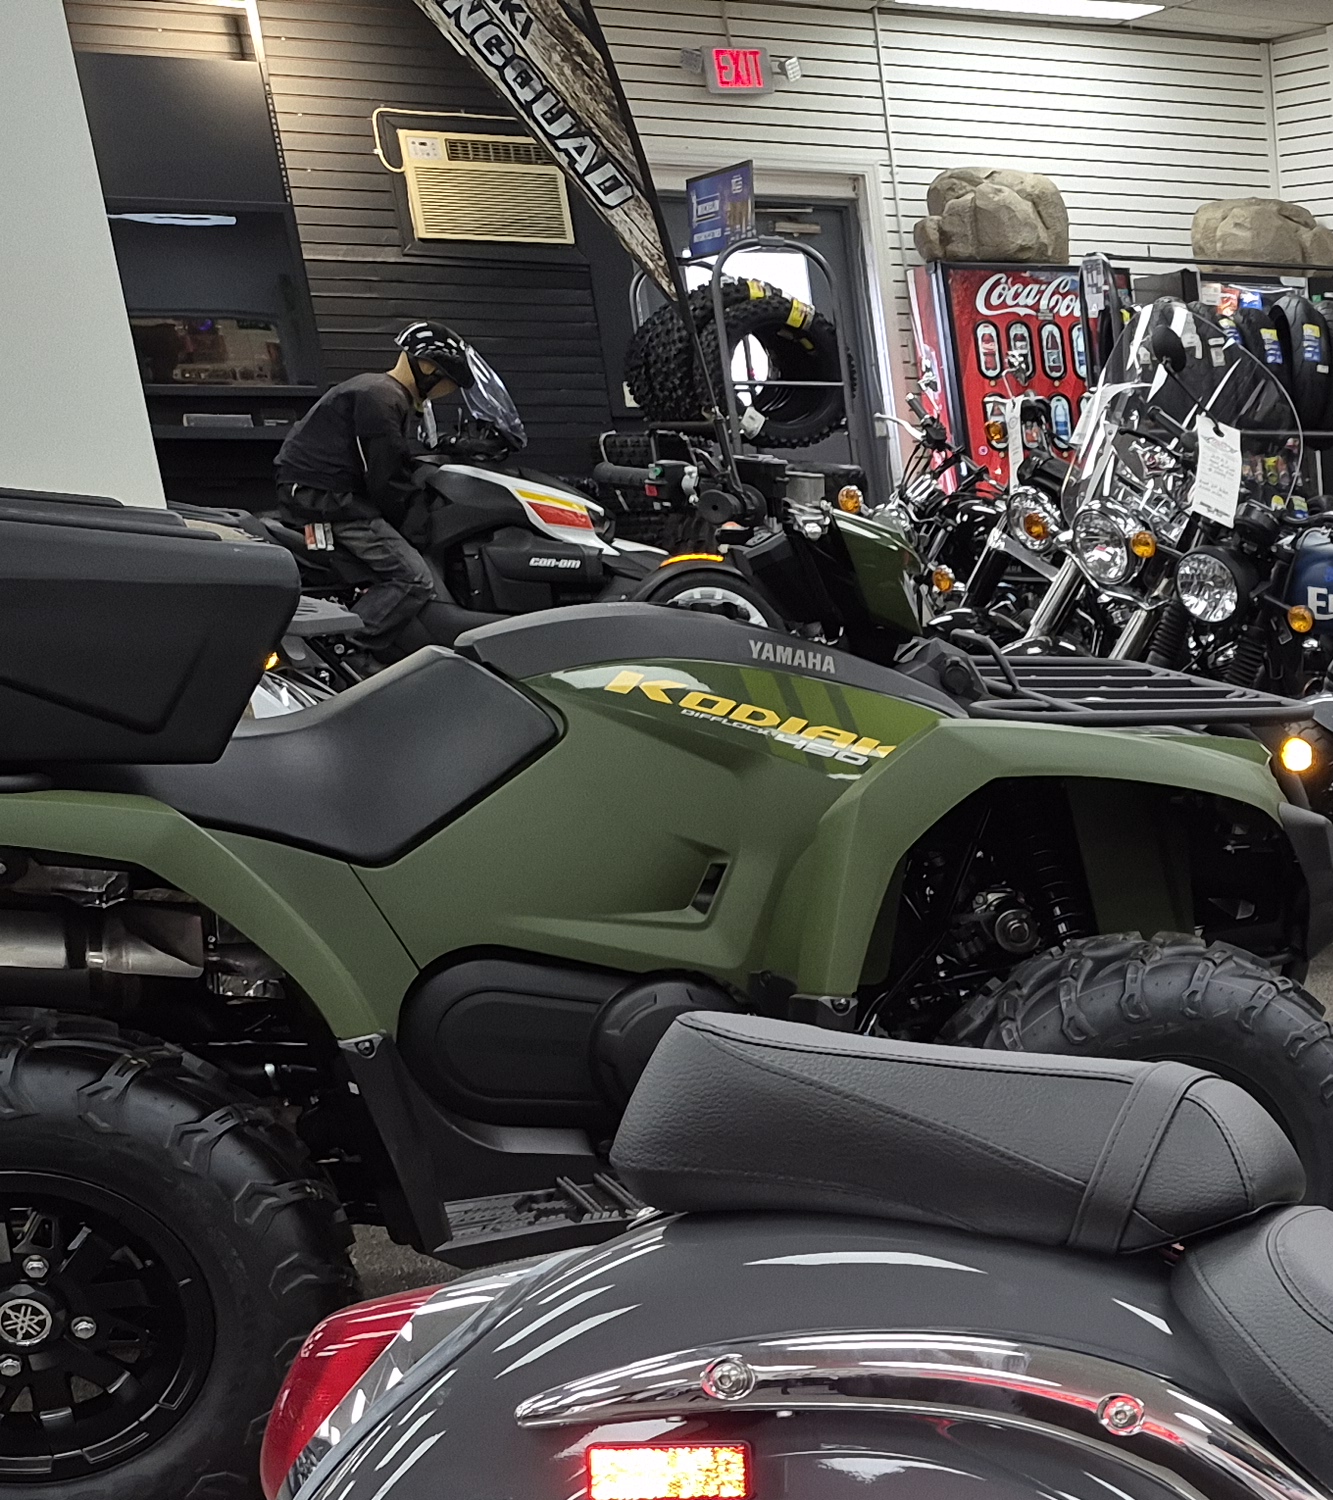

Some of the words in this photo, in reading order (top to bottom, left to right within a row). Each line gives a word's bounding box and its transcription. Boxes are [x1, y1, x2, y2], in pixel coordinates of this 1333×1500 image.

[713, 49, 764, 88] EXIT
[749, 639, 836, 674] YAMAHA
[603, 670, 898, 760] KODIAK
